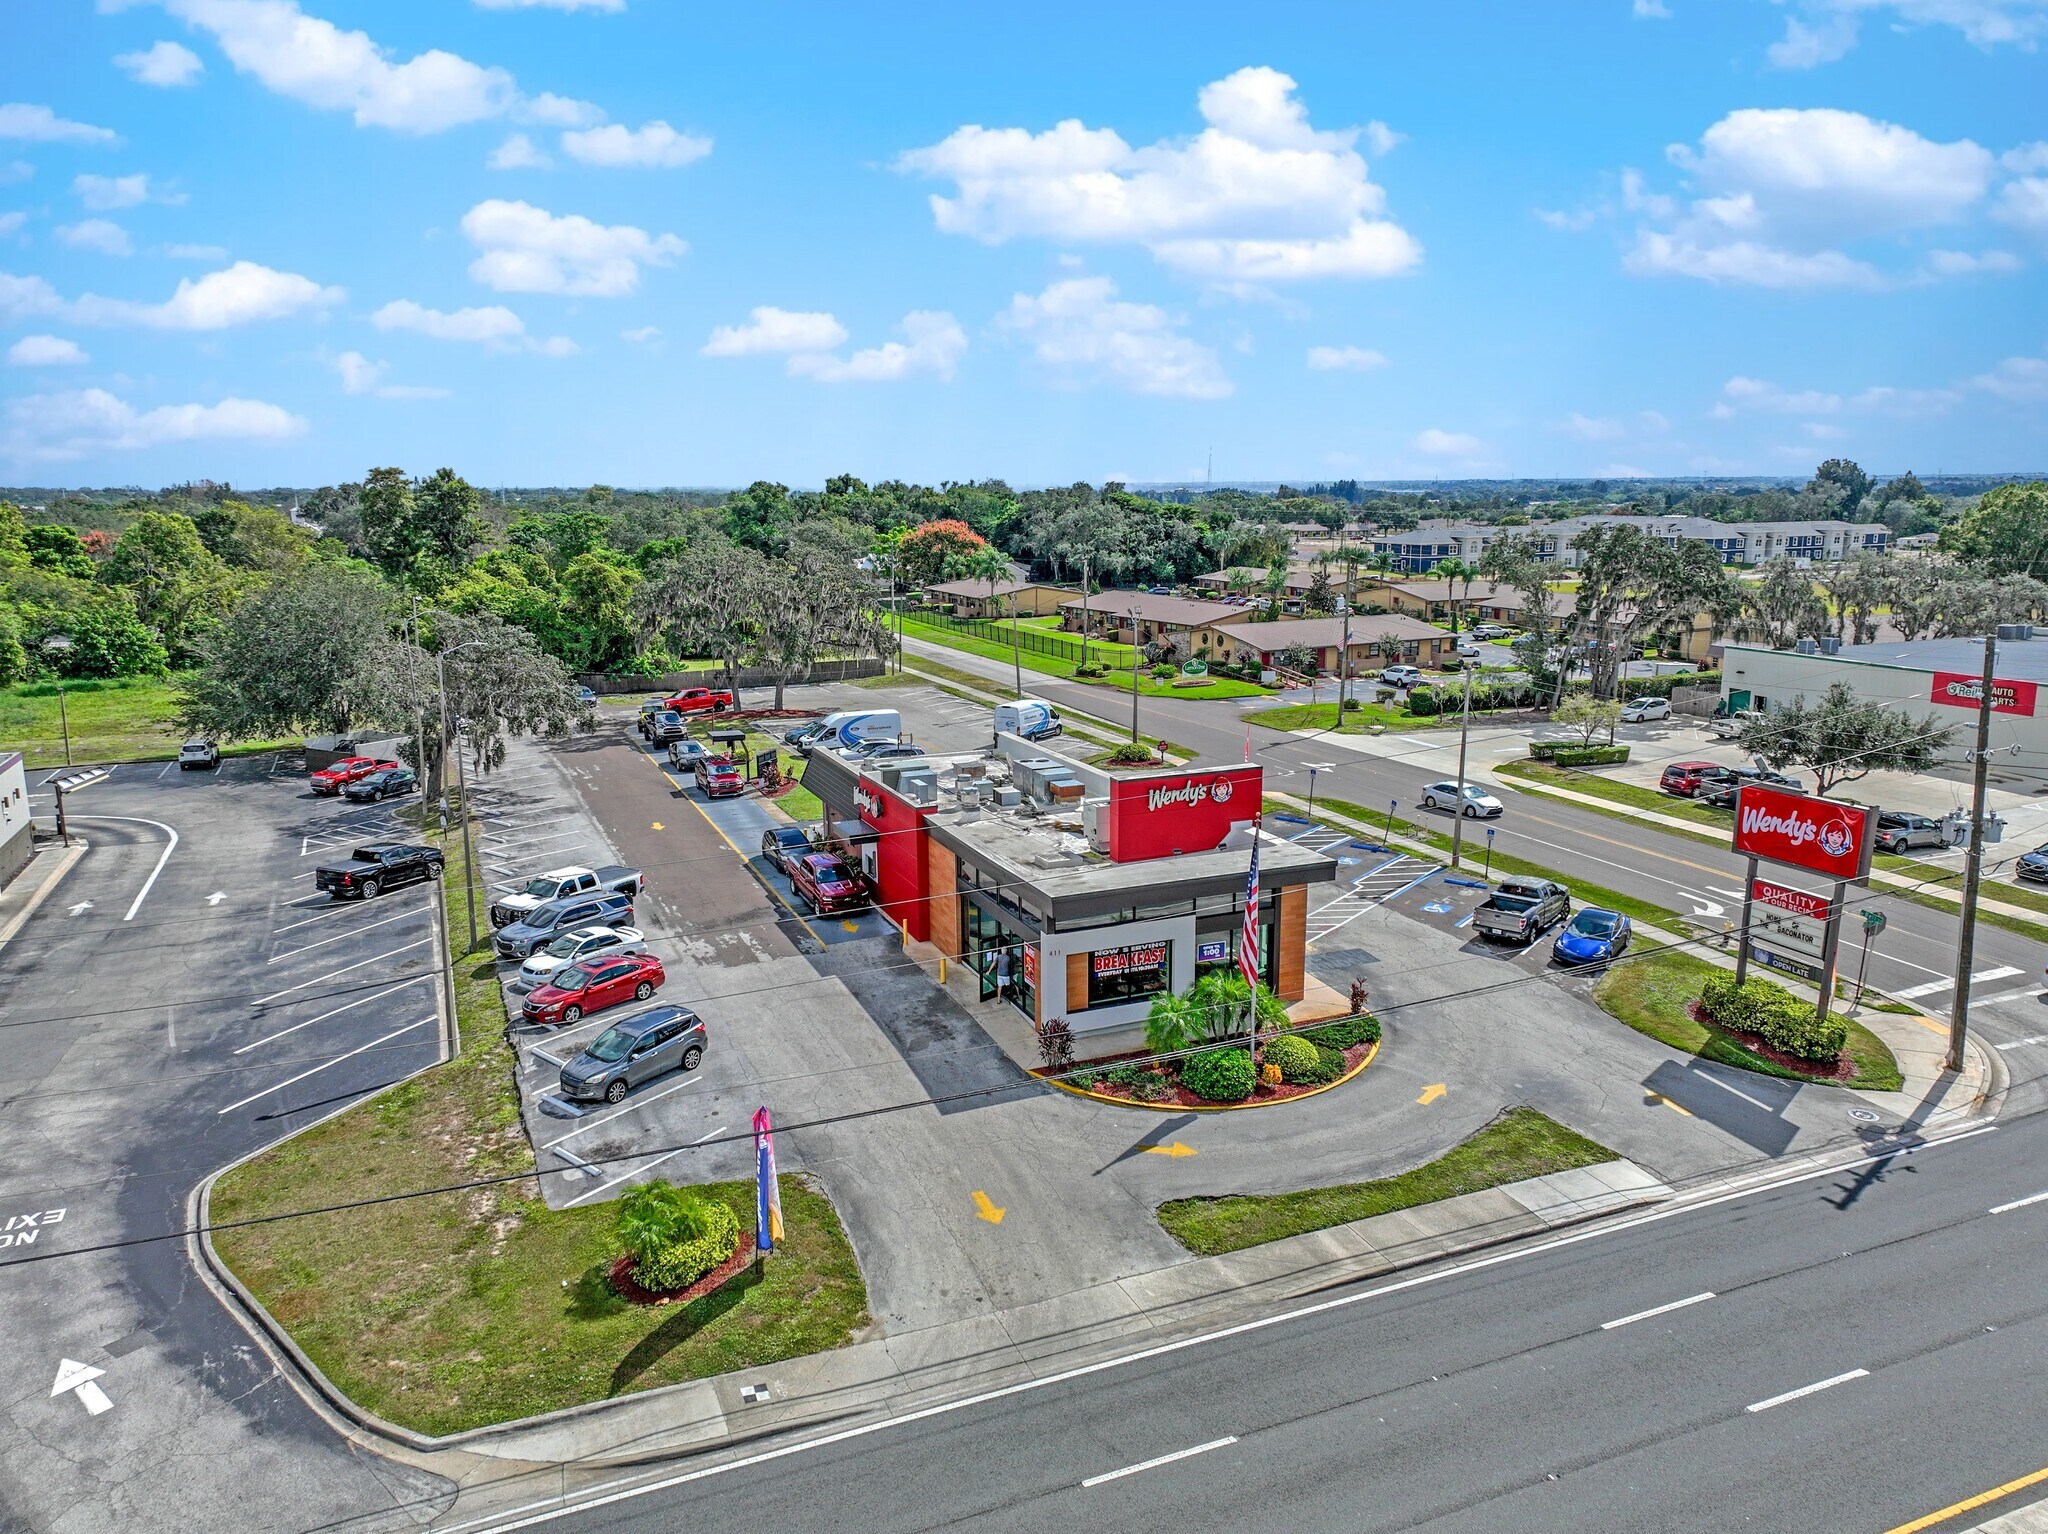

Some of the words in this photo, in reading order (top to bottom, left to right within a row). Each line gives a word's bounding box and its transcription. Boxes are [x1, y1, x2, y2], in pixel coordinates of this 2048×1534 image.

[1992, 687, 2014, 697] AUTO
[1148, 780, 1207, 812] Wendy's
[1742, 806, 1817, 846] Wendy's
[1763, 886, 1817, 910] QUALITY
[1770, 899, 1787, 909] OUR
[1094, 947, 1166, 973] BREAKFAST
[1095, 949, 1120, 957] NOW
[1122, 941, 1167, 954] SERVING
[1772, 960, 1792, 972] OPEN
[1792, 967, 1810, 978] LATE
[0, 1208, 67, 1232] EXI
